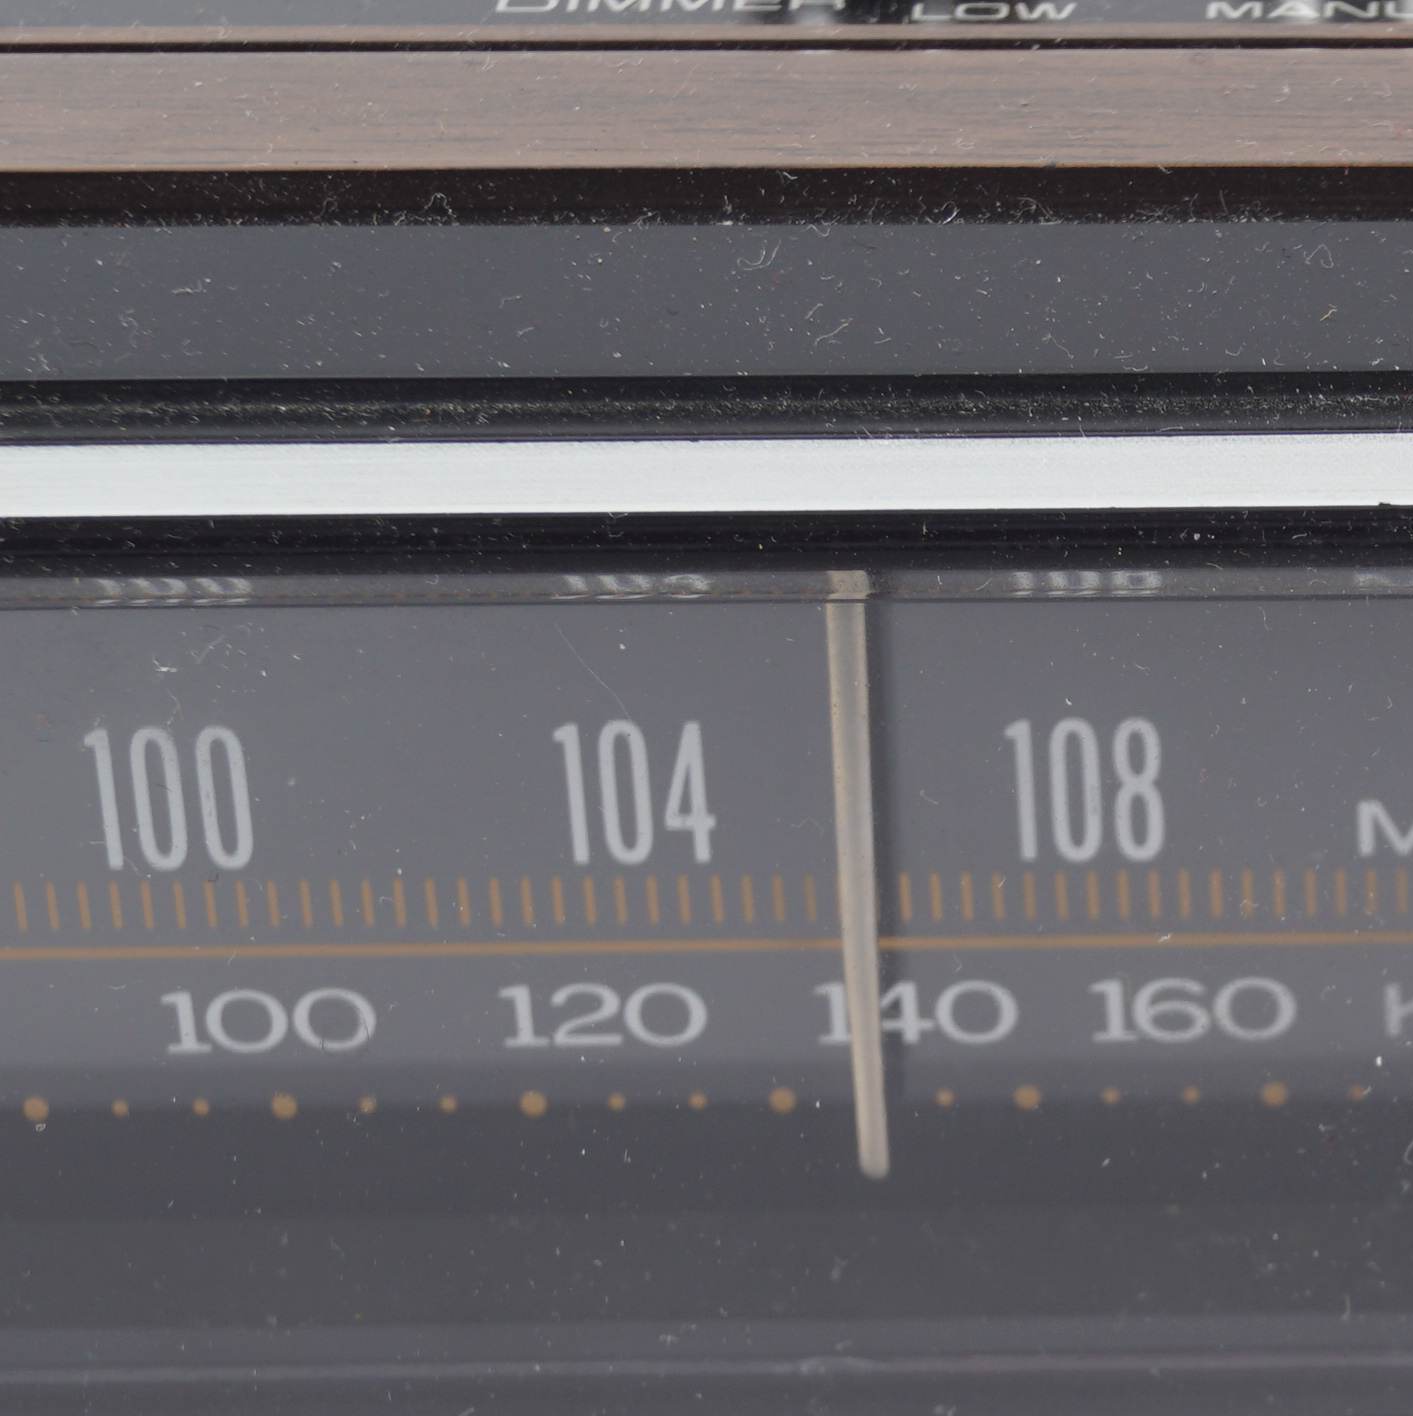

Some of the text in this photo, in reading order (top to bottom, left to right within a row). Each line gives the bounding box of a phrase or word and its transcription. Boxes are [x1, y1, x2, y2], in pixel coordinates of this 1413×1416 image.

[910, 1, 1078, 21] LOW
[83, 724, 254, 871] 100
[552, 718, 717, 865] 104
[1003, 716, 1167, 864] 108
[160, 986, 377, 1054] 100
[498, 981, 709, 1049] 120
[1089, 976, 1298, 1043] 160
